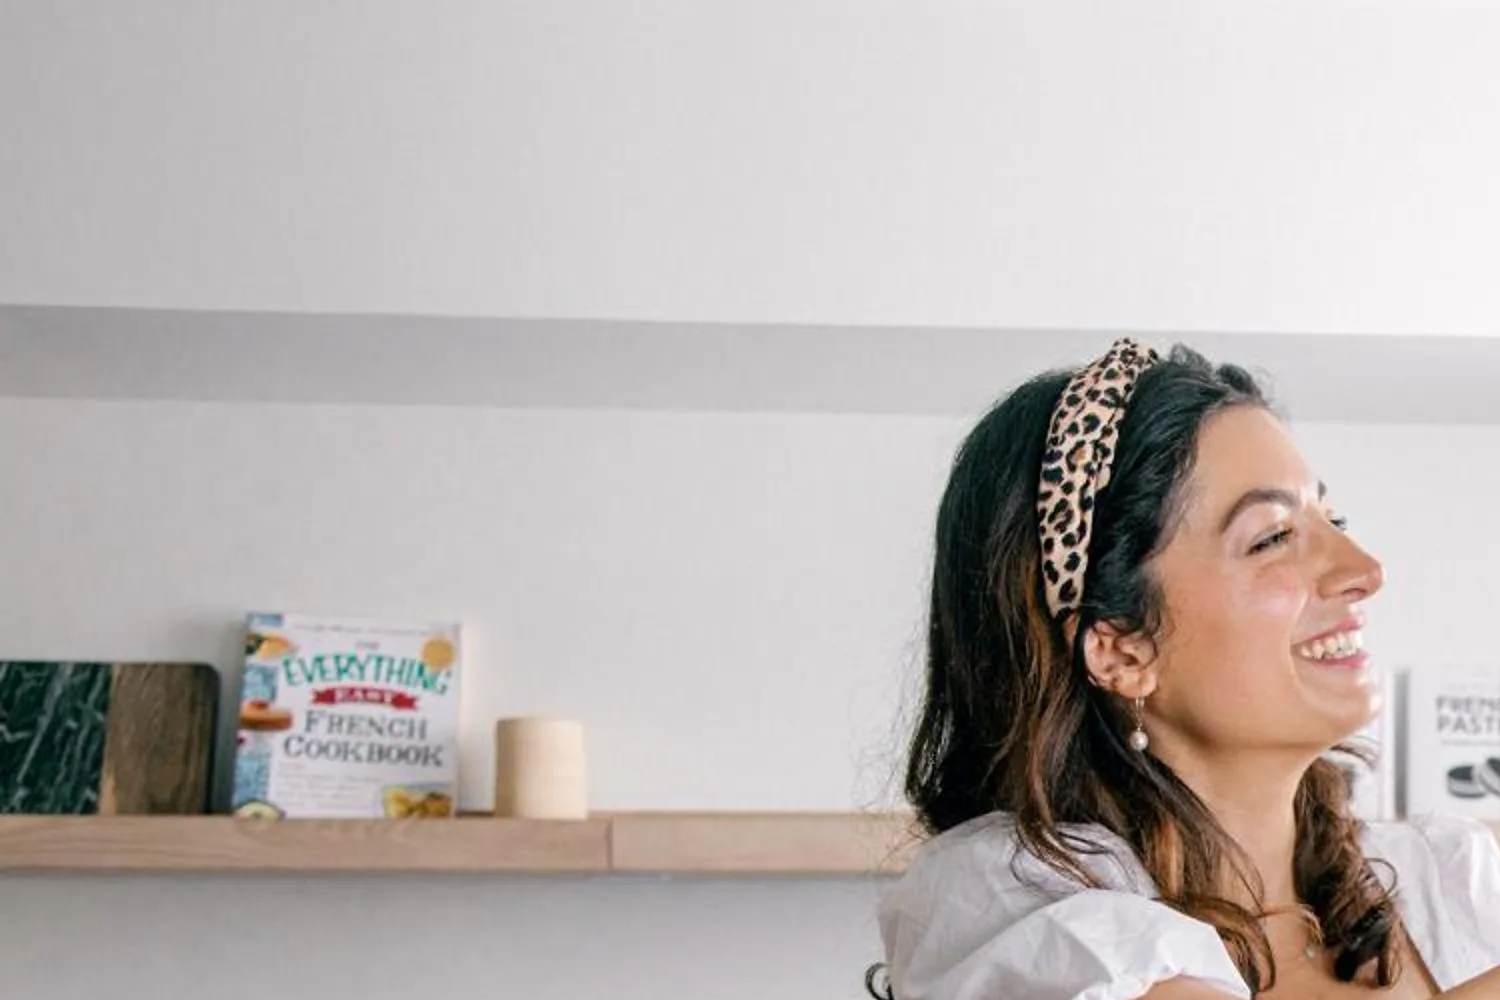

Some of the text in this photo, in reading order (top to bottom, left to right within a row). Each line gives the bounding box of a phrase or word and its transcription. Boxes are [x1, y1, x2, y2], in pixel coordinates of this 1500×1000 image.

[282, 651, 452, 695] EVERYTHING
[304, 709, 428, 740] FRENCH
[284, 735, 444, 767] COOKBOOK
